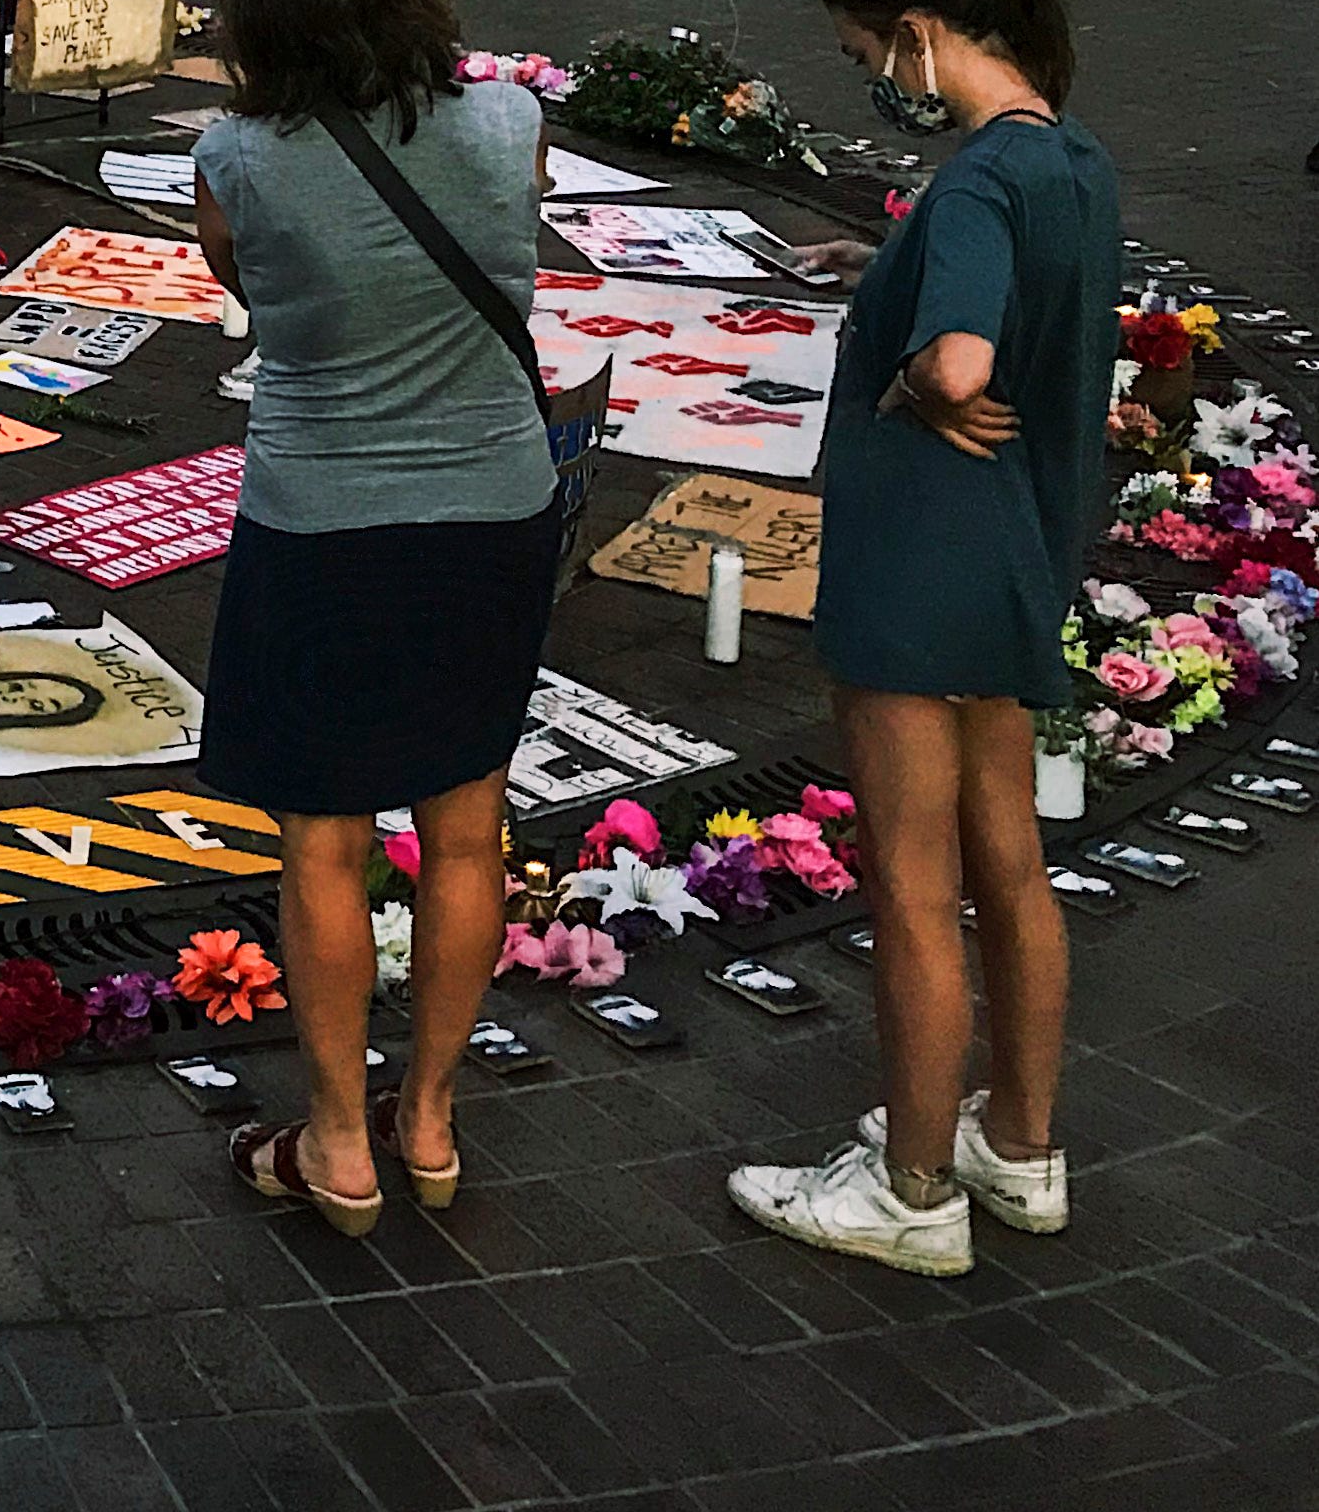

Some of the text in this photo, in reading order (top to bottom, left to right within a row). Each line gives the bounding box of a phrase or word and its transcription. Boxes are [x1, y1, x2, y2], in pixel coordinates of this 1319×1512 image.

[41, 16, 107, 46] SAVE THE
[63, 37, 113, 64] PLANET
[50, 481, 153, 512] HER
[11, 497, 173, 551] BREONNA
[49, 529, 142, 567] SAY
[124, 507, 229, 541] HER
[75, 633, 187, 720] Justice
